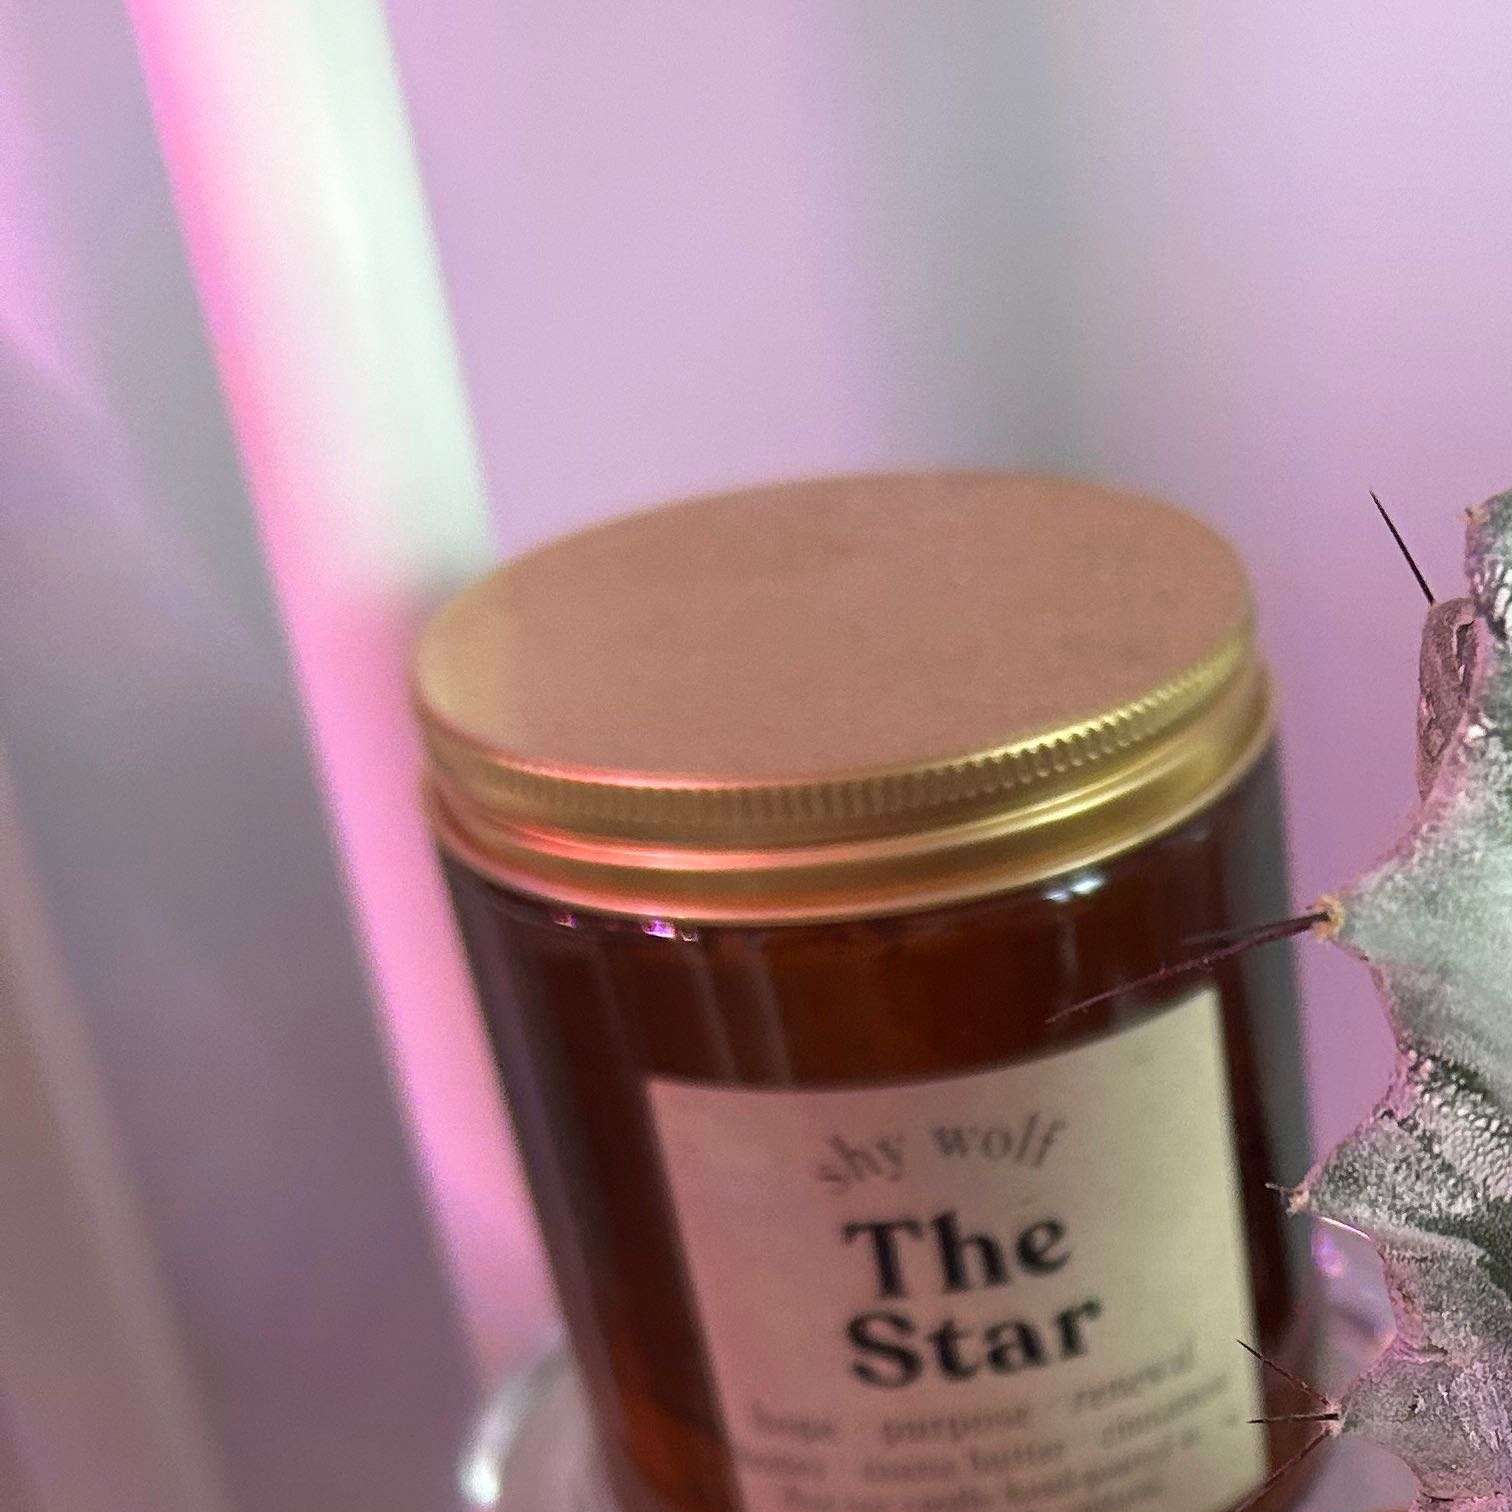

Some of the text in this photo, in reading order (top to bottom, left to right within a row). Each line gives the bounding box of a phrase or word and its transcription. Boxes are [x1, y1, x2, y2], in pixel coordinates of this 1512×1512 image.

[931, 1110, 1067, 1169] wolf
[841, 1210, 1072, 1300] The
[844, 1298, 1104, 1388] Star
